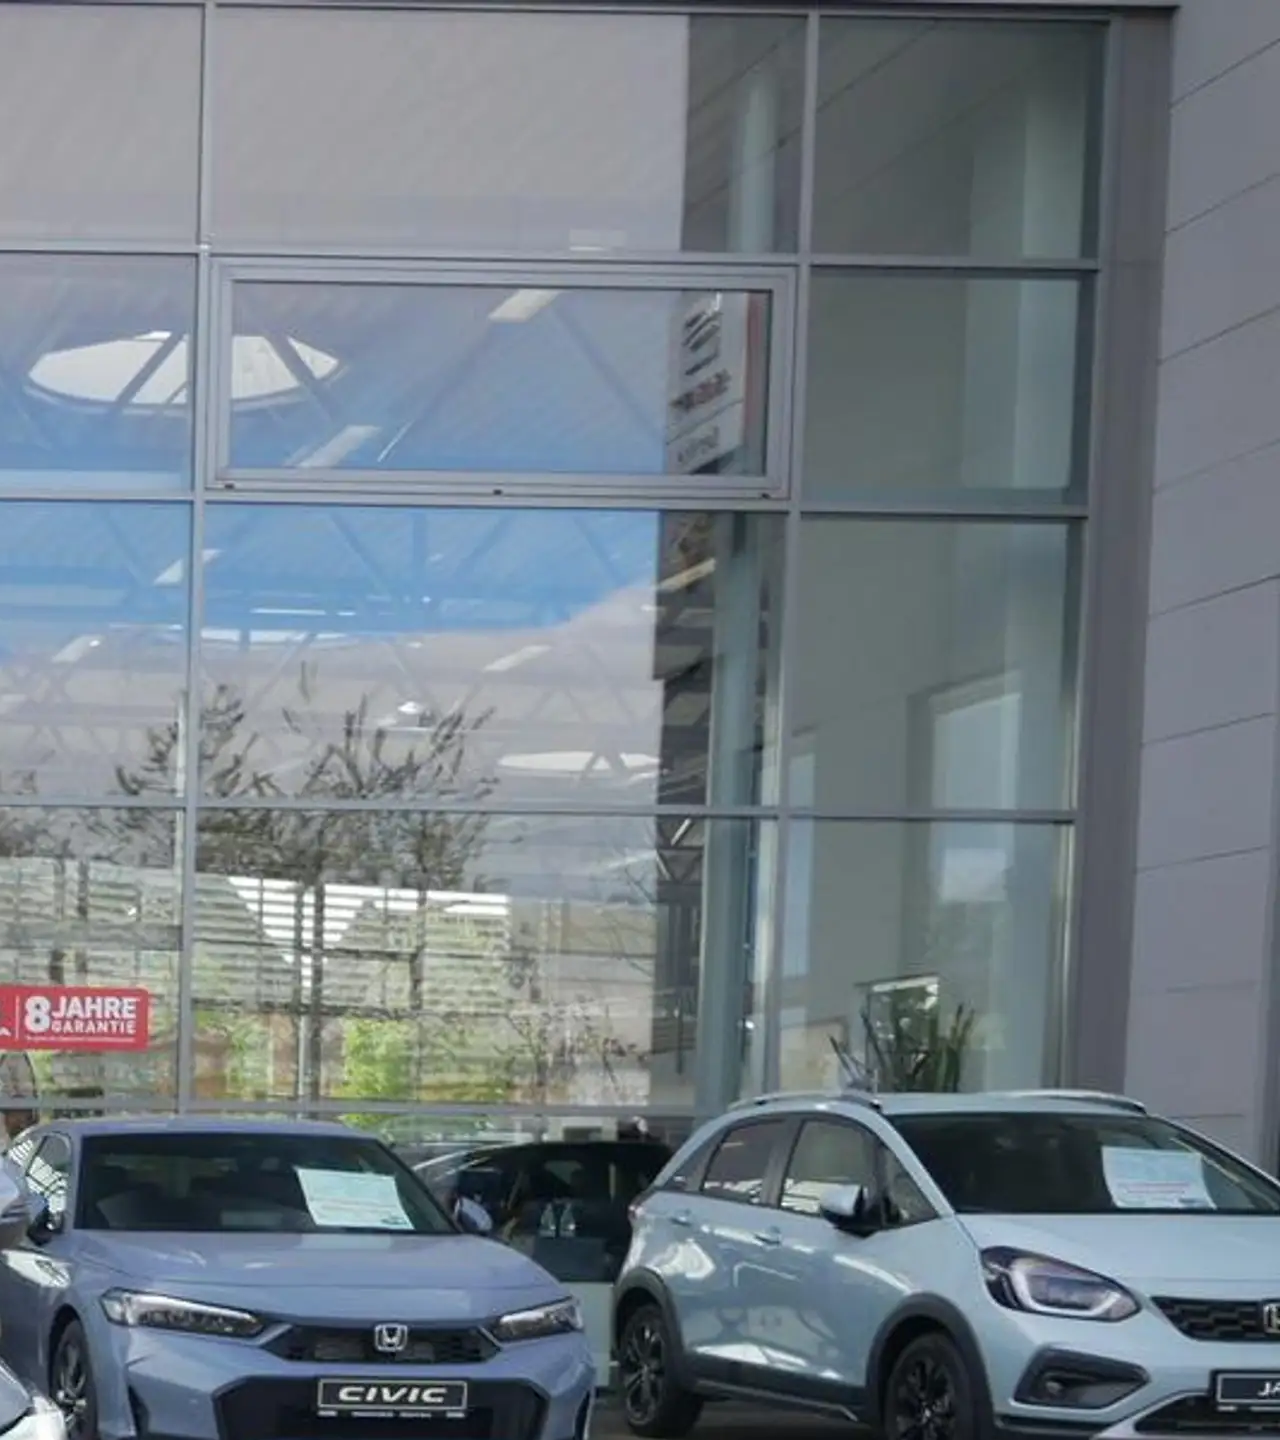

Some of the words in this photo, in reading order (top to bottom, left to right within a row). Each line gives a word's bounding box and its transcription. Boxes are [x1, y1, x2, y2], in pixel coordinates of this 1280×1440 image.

[25, 996, 50, 1032] 8
[52, 996, 137, 1019] JAHRE
[52, 1020, 136, 1034] GARANTIE
[339, 1386, 448, 1403] CIVIC
